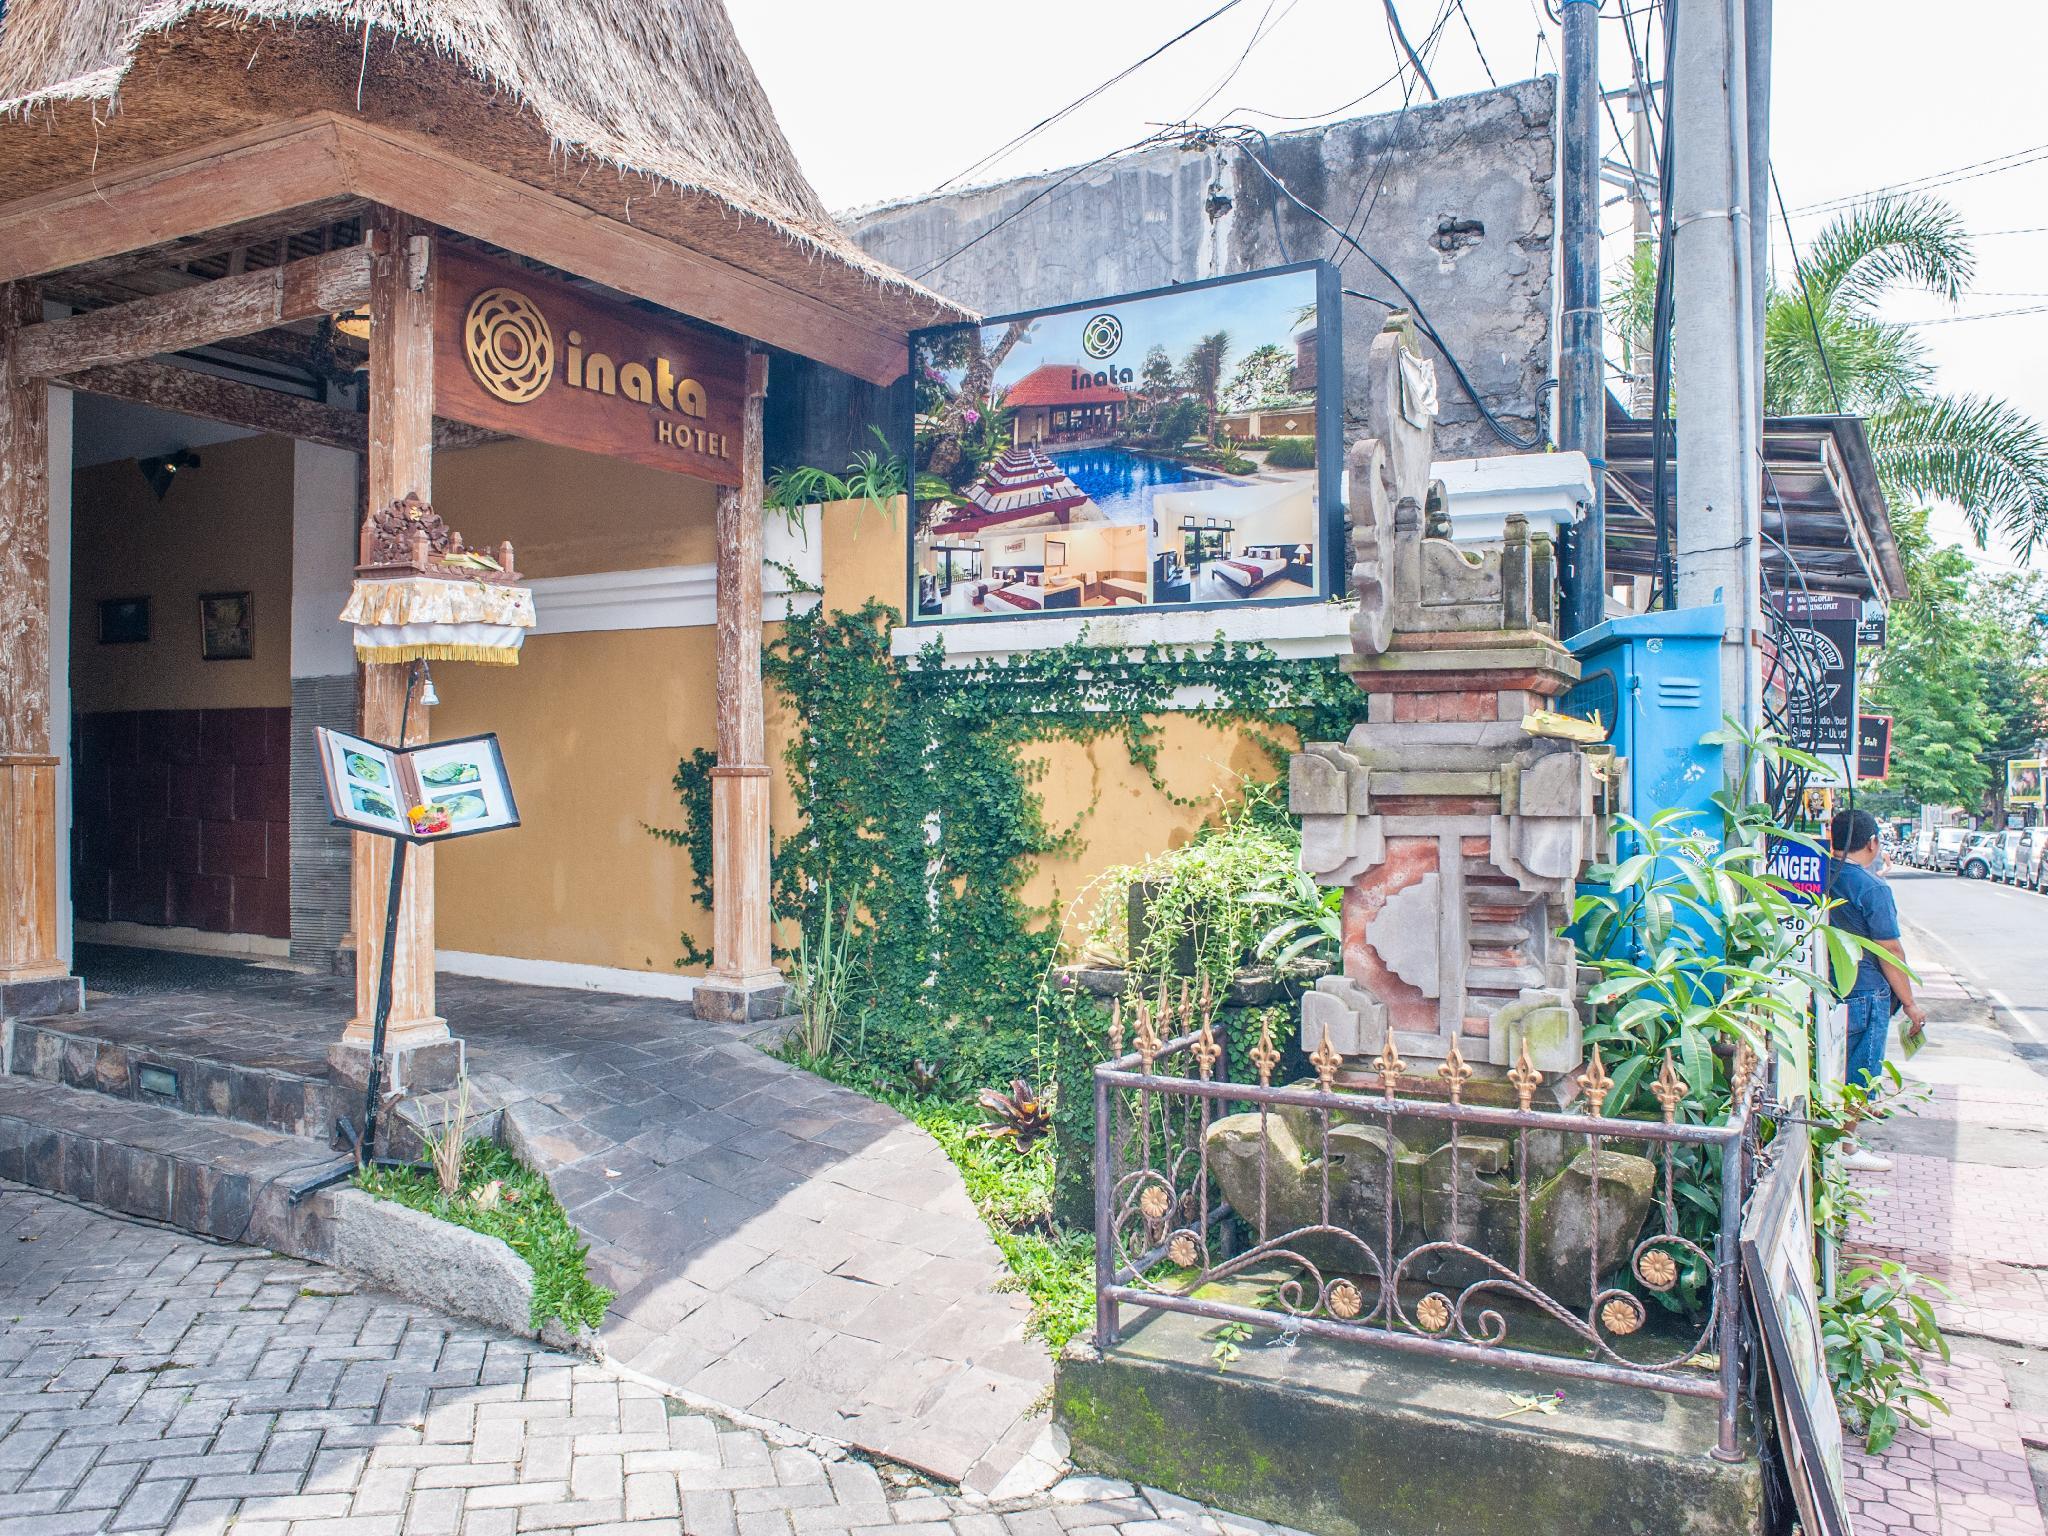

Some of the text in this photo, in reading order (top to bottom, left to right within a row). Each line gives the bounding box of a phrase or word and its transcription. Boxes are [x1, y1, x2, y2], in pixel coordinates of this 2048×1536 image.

[567, 329, 708, 419] inata
[1071, 364, 1134, 391] inata
[1108, 385, 1135, 393] HOTEL
[658, 419, 731, 460] HOTEL
[1814, 637, 1837, 664] TATTOO
[1766, 853, 1821, 882] ANGER
